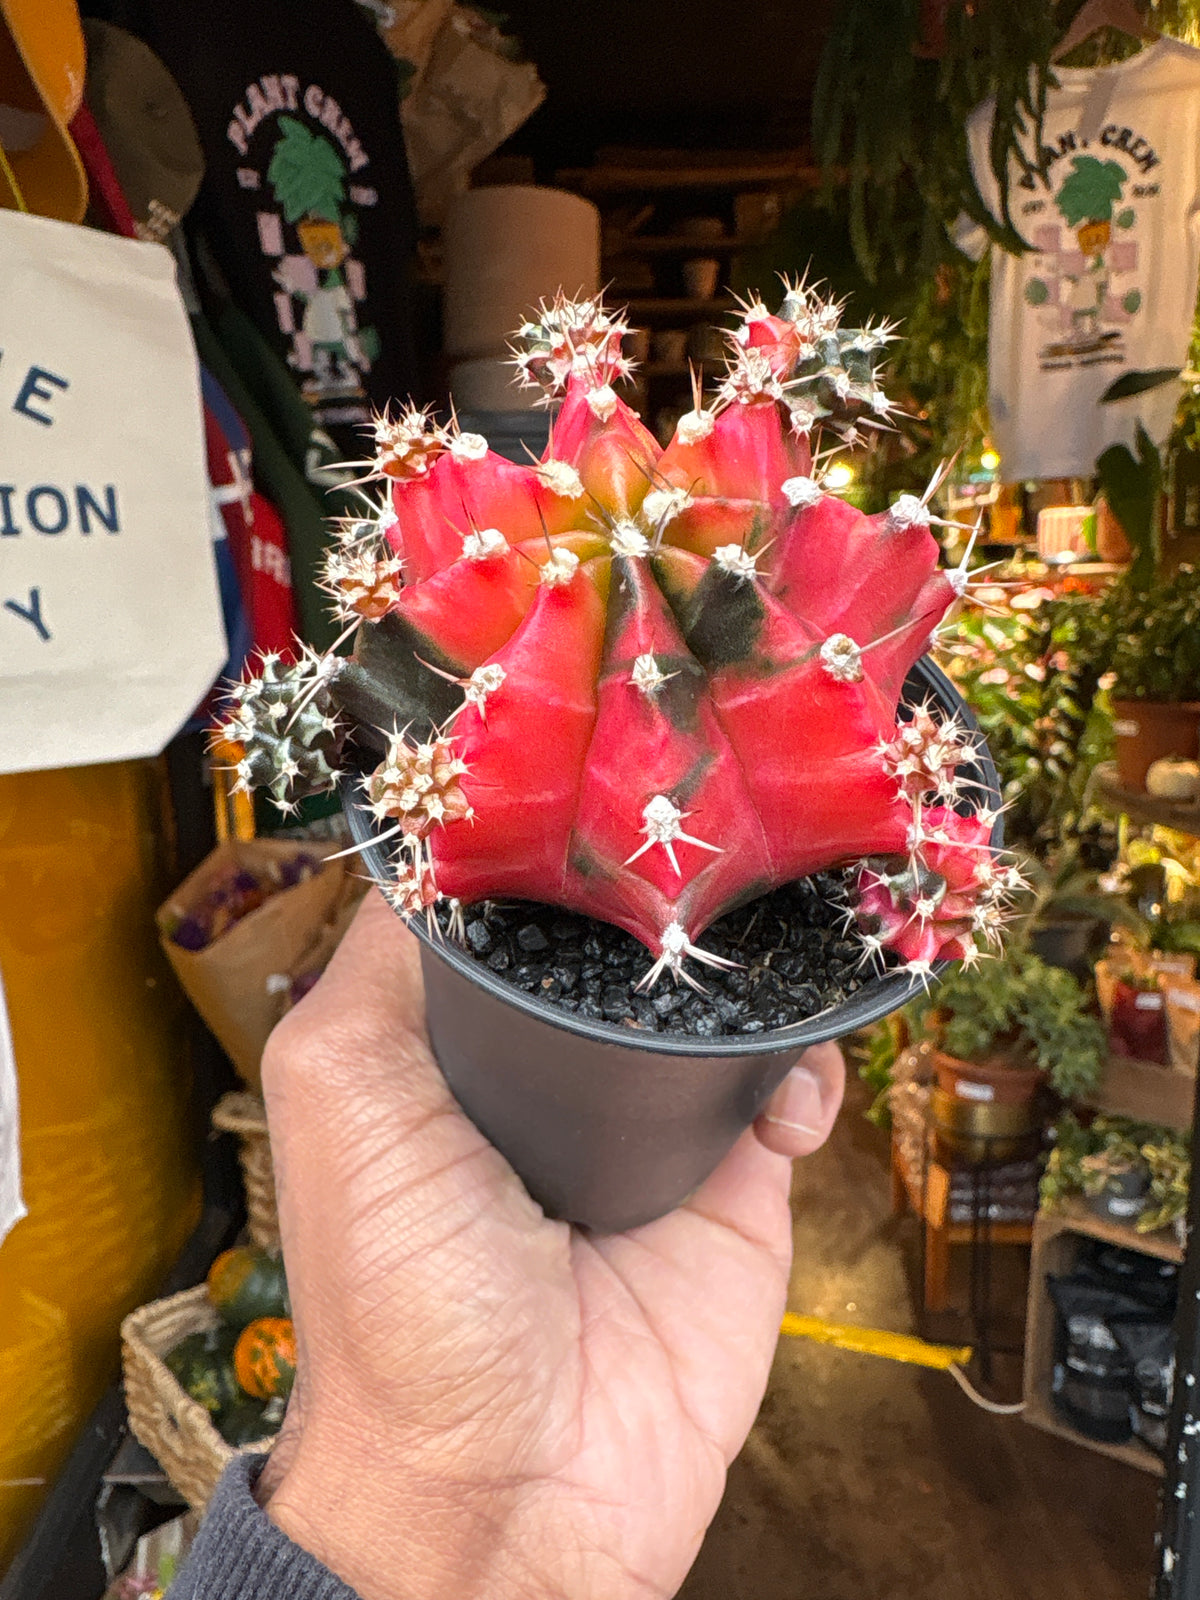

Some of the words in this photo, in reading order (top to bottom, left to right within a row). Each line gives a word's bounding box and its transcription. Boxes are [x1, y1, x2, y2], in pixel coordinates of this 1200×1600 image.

[227, 74, 299, 156] PLANT
[2, 352, 70, 427] E
[5, 585, 51, 642] Y
